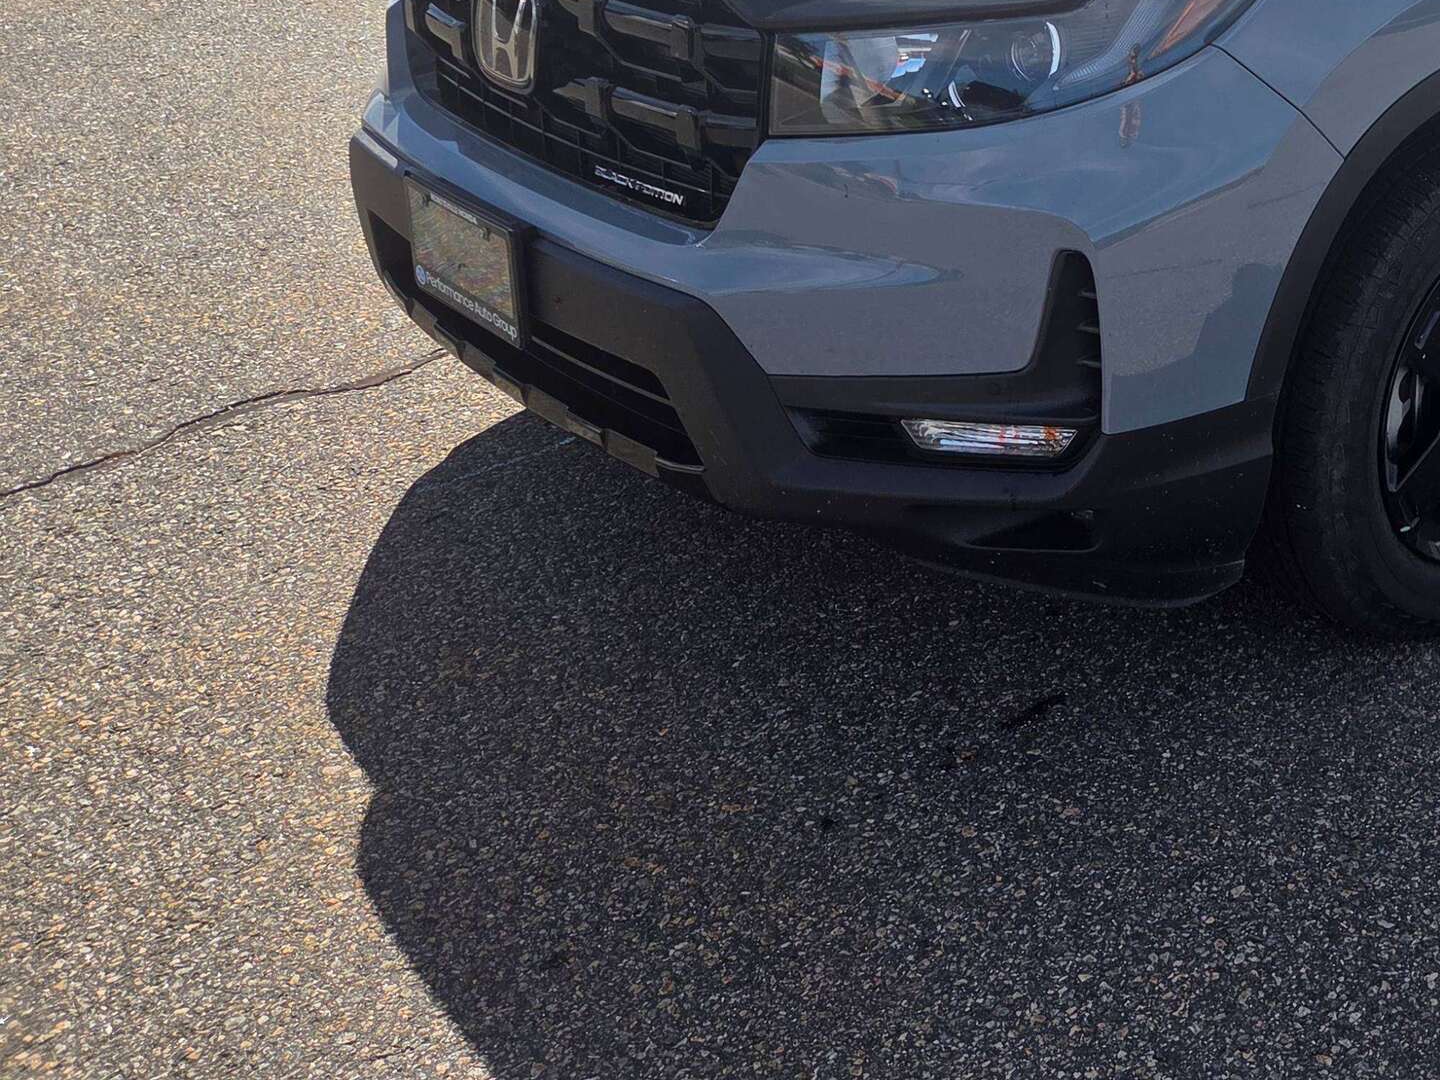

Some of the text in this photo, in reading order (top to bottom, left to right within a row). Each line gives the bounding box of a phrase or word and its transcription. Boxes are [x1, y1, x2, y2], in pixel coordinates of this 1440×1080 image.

[427, 271, 518, 341] Performance Auto Group
